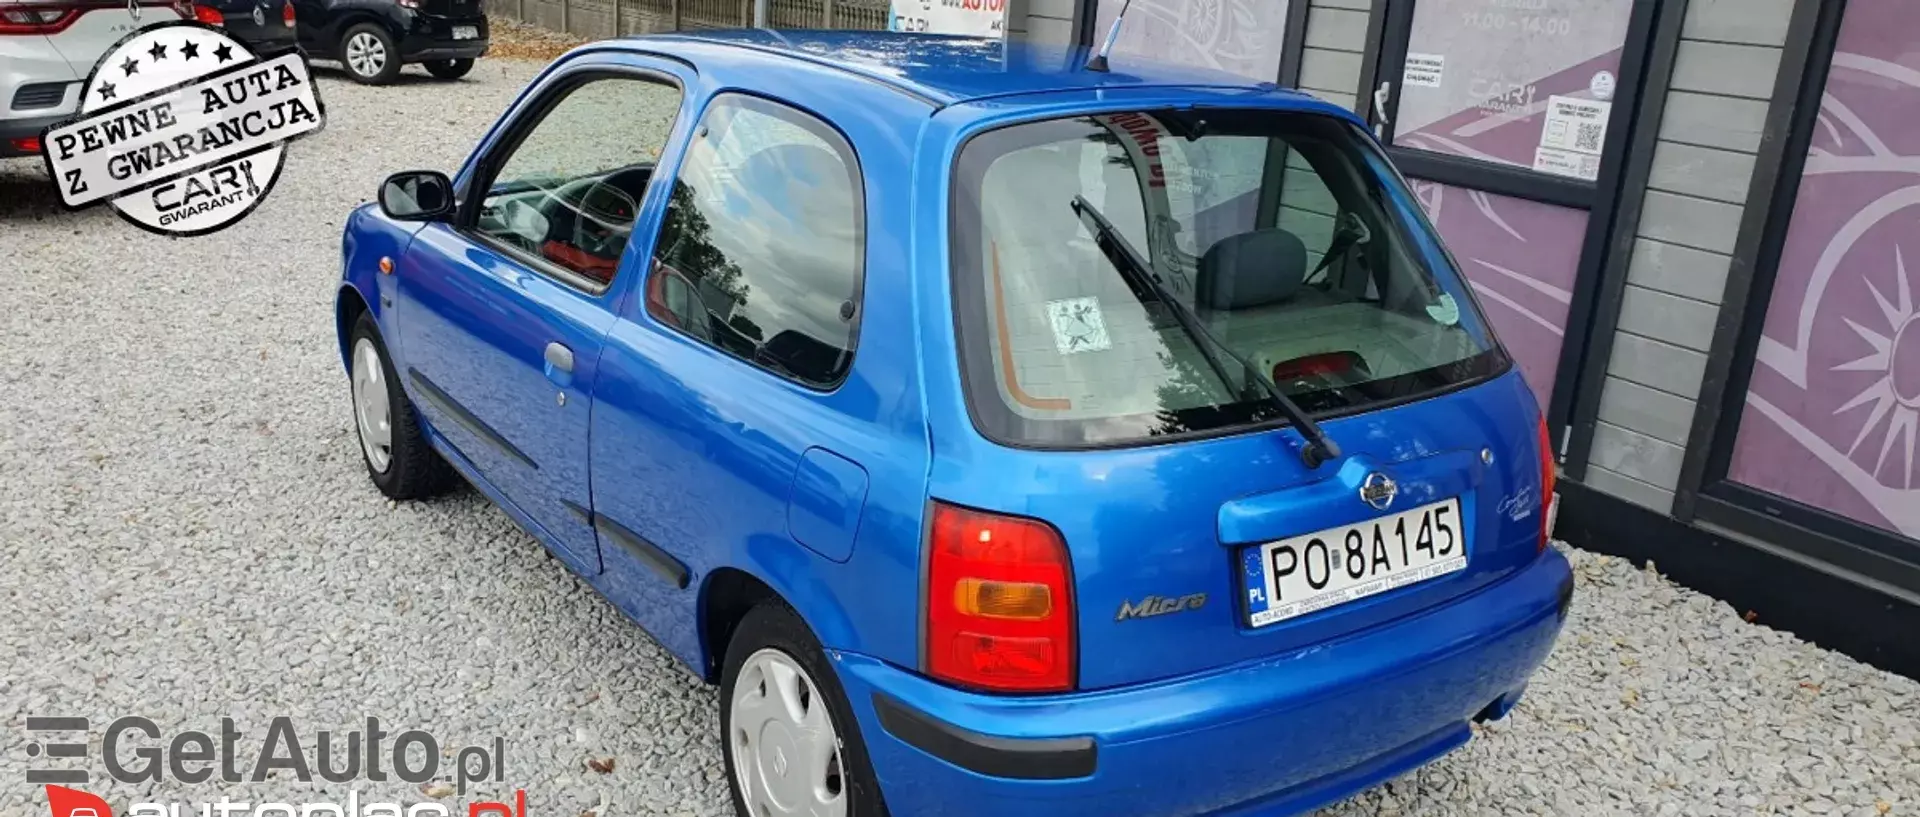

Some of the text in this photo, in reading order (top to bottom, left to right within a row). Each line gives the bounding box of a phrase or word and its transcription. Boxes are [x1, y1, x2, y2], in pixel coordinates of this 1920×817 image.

[1271, 506, 1454, 601] PO 8A145
[1250, 588, 1265, 603] PL
